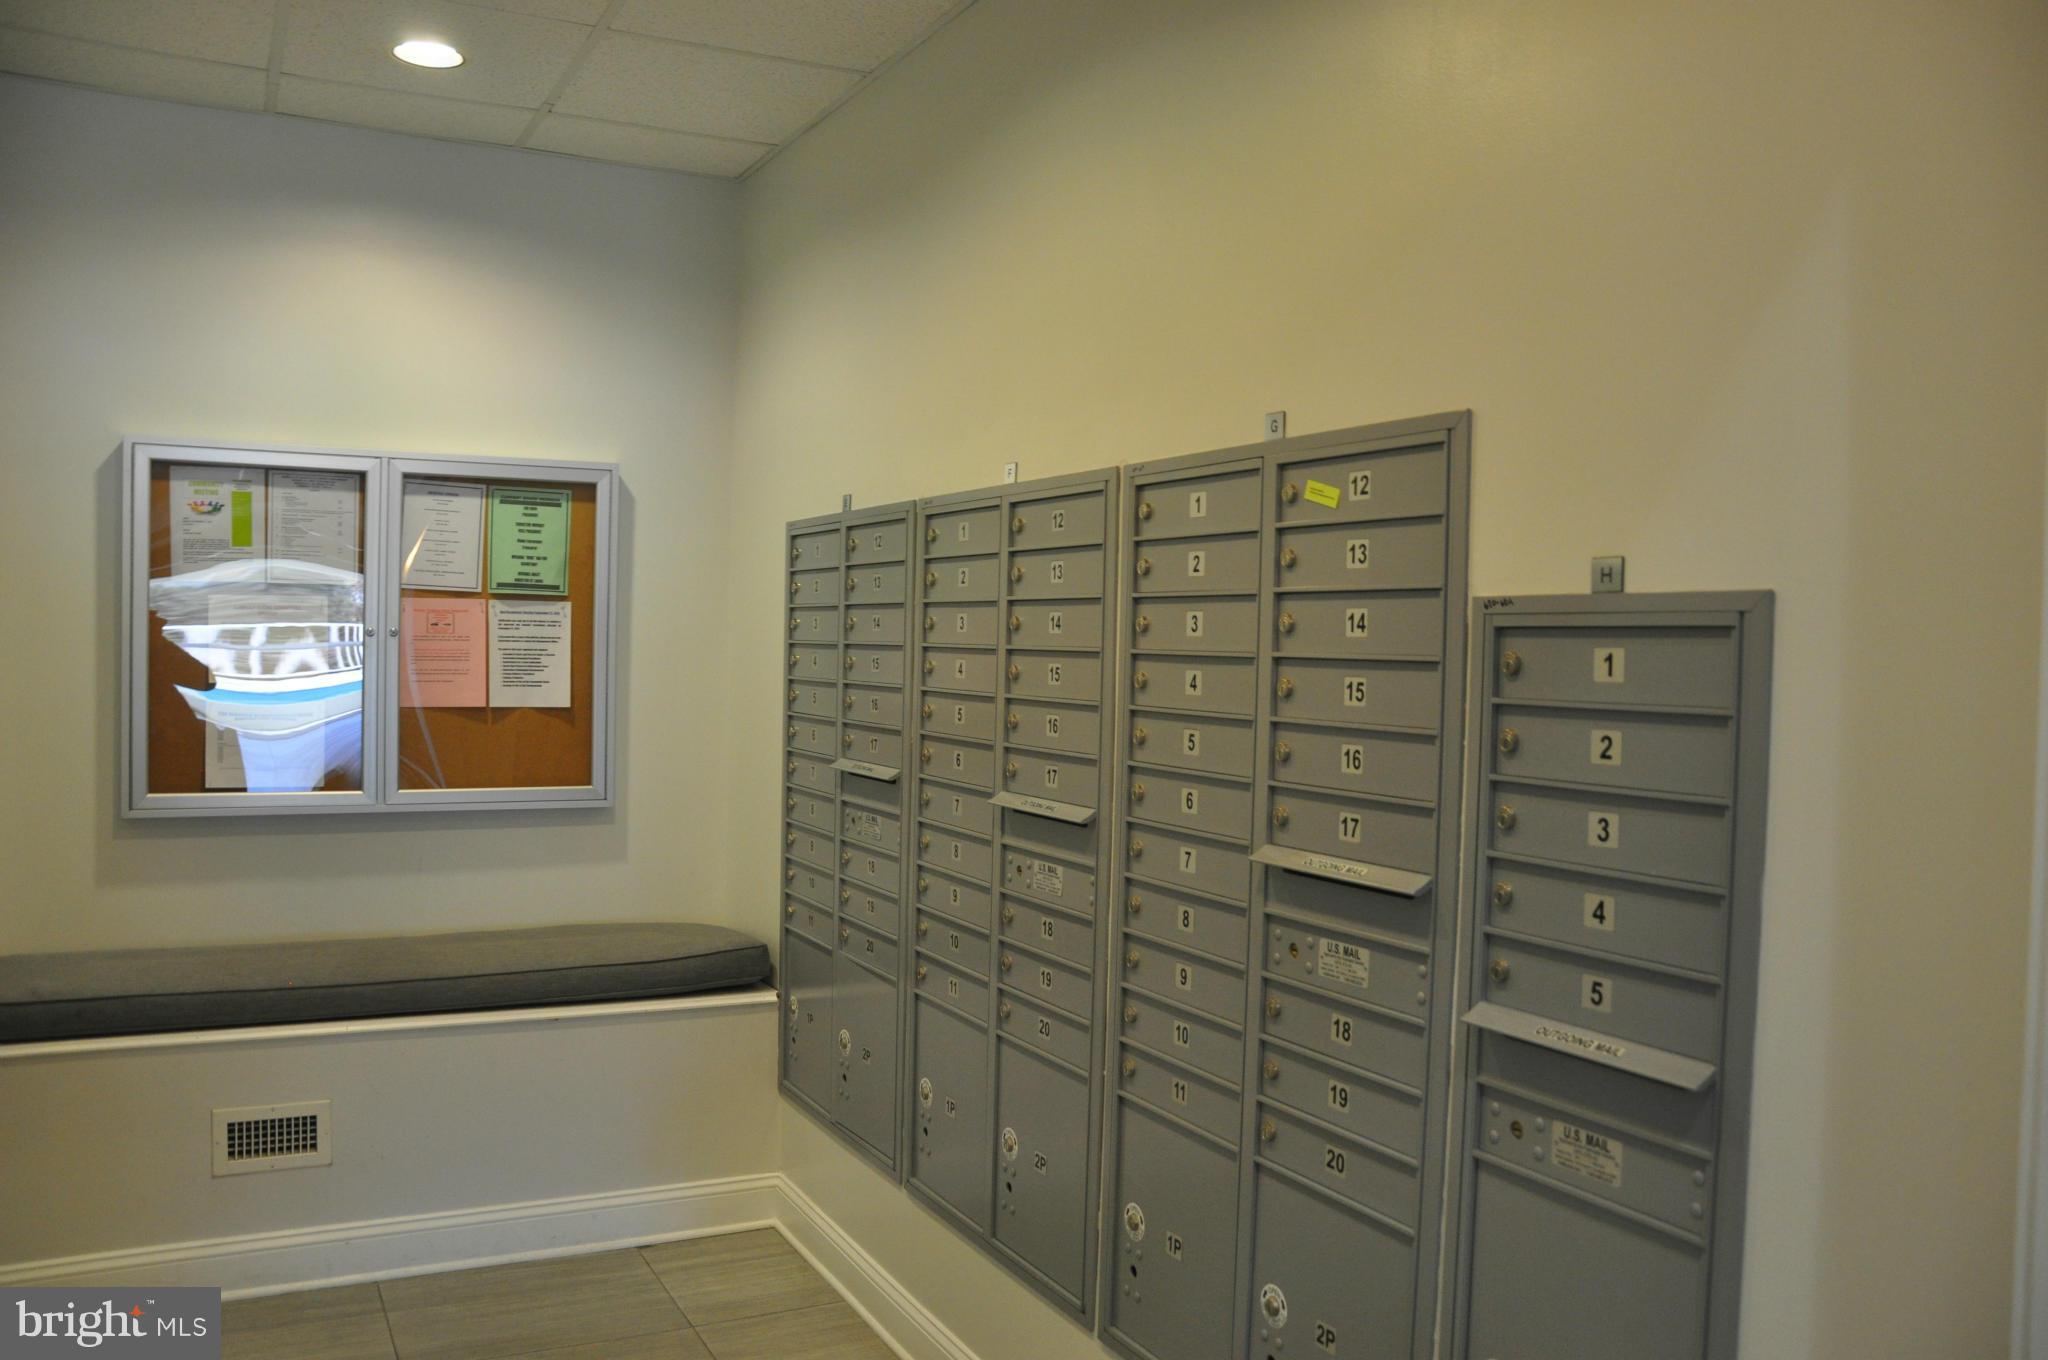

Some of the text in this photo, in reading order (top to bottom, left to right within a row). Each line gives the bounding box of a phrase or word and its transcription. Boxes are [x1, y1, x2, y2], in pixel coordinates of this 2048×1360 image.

[1271, 420, 1278, 433] G
[1351, 475, 1369, 495] 12
[1195, 496, 1201, 512] 1
[1053, 513, 1064, 529] 12
[961, 525, 966, 539] 1
[1349, 544, 1367, 564] 13
[1052, 565, 1063, 580] 13
[1193, 556, 1200, 573] 2
[960, 570, 966, 584] 2
[1601, 567, 1612, 583] H
[959, 616, 964, 630] 3
[1050, 616, 1061, 631] 14
[1191, 615, 1198, 632] 3
[1348, 613, 1366, 633] 14
[958, 662, 963, 676] 4
[1604, 653, 1613, 677] 1
[1049, 667, 1060, 682] 15
[1189, 674, 1197, 691] 4
[1346, 681, 1365, 702] 15
[957, 708, 962, 721] 5
[1048, 718, 1058, 733] 16
[1188, 733, 1195, 751] 5
[1600, 735, 1613, 760] 2
[955, 753, 961, 767] 6
[1344, 749, 1361, 770] 16
[1046, 769, 1057, 785] 17
[955, 800, 960, 813] 7
[1186, 792, 1194, 809] 6
[1341, 818, 1359, 838] 17
[1597, 817, 1610, 842] 3
[954, 845, 959, 858] 8
[1184, 851, 1191, 869] 7
[952, 889, 957, 903] 9
[1182, 910, 1190, 928] 8
[1592, 900, 1606, 925] 4
[1042, 920, 1053, 937] 18
[950, 933, 958, 949] 10
[1327, 941, 1361, 961] U.S. MAIL
[1041, 970, 1051, 987] 19
[1180, 968, 1187, 986] 9
[950, 980, 957, 995] 11
[1590, 981, 1603, 1006] 5
[1039, 1019, 1050, 1037] 20
[1175, 1025, 1189, 1044] 10
[1333, 1018, 1351, 1041] 18
[1174, 1081, 1186, 1101] 11
[1330, 1085, 1348, 1108] 19
[946, 1100, 955, 1114] 1P
[1563, 1126, 1611, 1153] U.S. MAIL
[1034, 1153, 1046, 1170] 2P
[1326, 1149, 1345, 1173] 20
[1167, 1236, 1182, 1254] 1P
[1316, 1325, 1336, 1347] 2P
